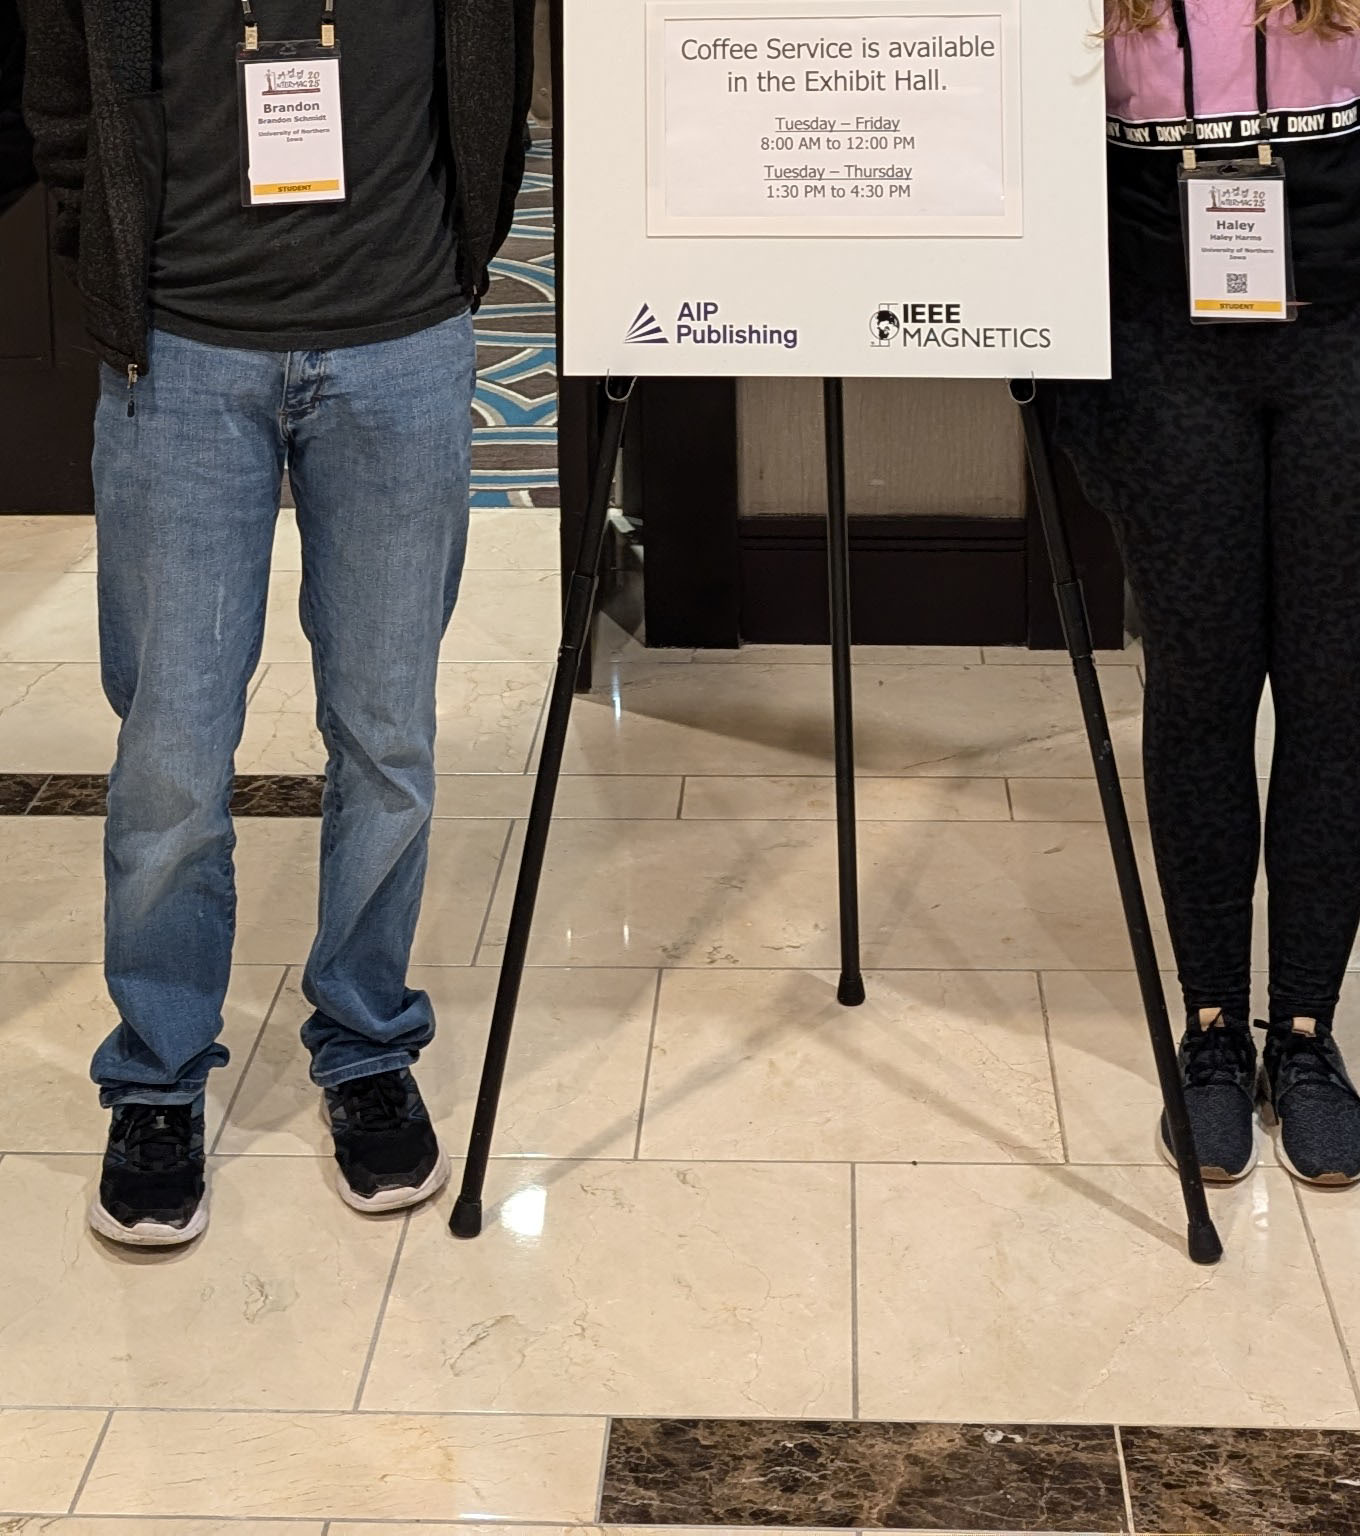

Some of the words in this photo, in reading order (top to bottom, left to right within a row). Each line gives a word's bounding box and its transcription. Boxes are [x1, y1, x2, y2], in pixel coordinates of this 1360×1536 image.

[681, 37, 758, 60] Coffee
[766, 37, 853, 60] Service
[862, 37, 880, 58] is
[888, 35, 996, 58] available
[728, 71, 747, 92] in
[757, 71, 796, 92] the
[805, 69, 886, 92] Exhibit
[895, 69, 947, 91] Hall.
[263, 102, 320, 113] Brandon
[775, 117, 837, 133] Tuesday
[855, 116, 900, 132] Friday
[1196, 121, 1233, 140] DKNY
[1288, 113, 1326, 133] DKNY
[760, 137, 794, 150] 8:00
[798, 137, 821, 150] AM
[826, 138, 841, 150] to
[847, 136, 888, 150] 12:00
[894, 136, 915, 149] PM
[764, 165, 825, 181] Tuesday
[844, 164, 912, 180] Thursday
[278, 184, 312, 193] STUDENT
[767, 185, 799, 198] 1:30
[804, 185, 825, 198] PM
[831, 186, 846, 198] to
[850, 185, 884, 198] 4:30
[889, 184, 911, 197] PM
[1216, 220, 1255, 232] Haley
[677, 302, 719, 322] AIP
[903, 303, 961, 323] IEEE
[676, 324, 798, 348] Publishing
[903, 328, 1051, 348] MAGNETICS
